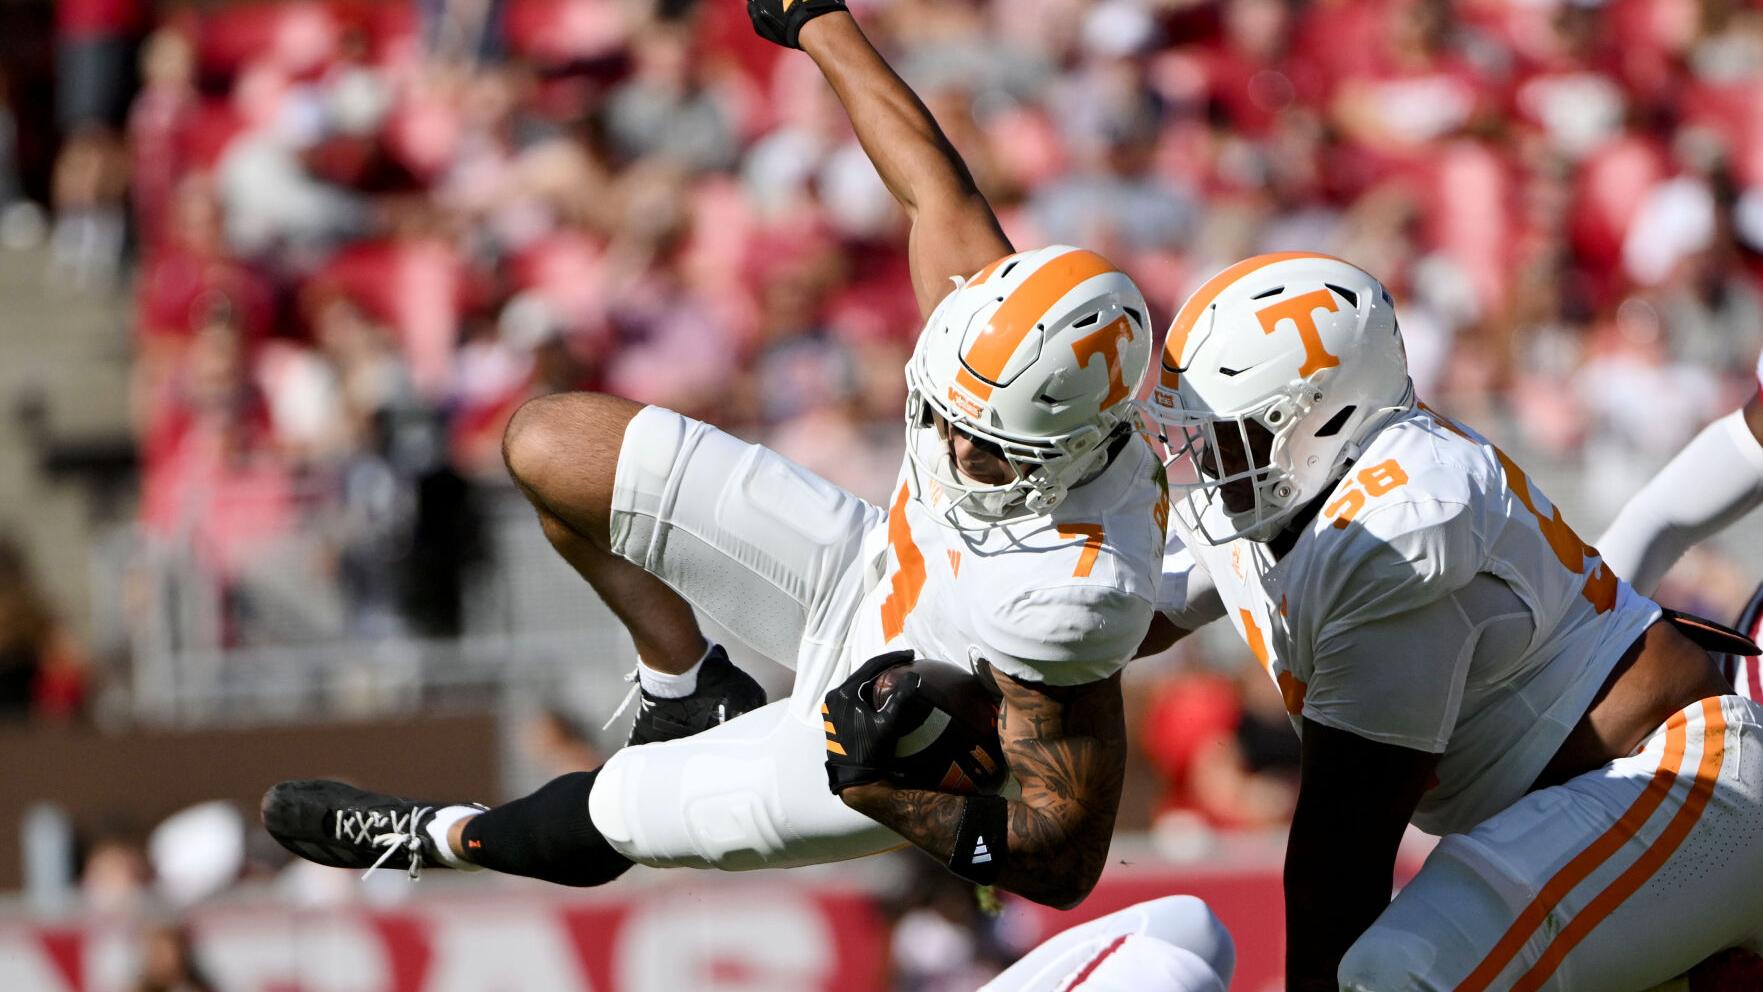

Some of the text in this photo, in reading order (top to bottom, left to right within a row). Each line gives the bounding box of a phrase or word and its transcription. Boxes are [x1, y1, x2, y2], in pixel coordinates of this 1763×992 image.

[1071, 313, 1135, 413] T
[1254, 288, 1340, 379] T
[1324, 458, 1409, 530] 58
[1056, 522, 1105, 578] 7
